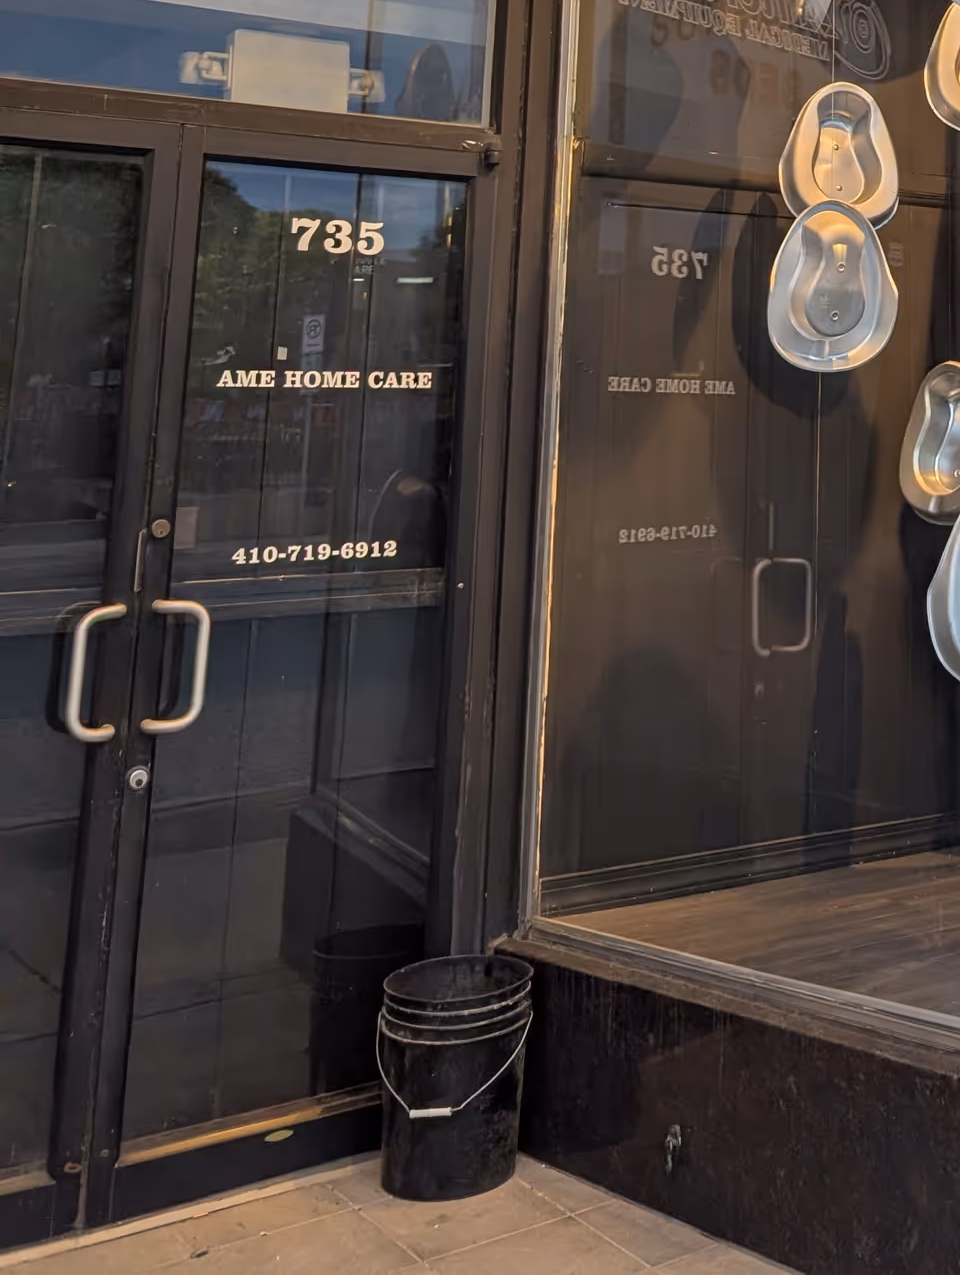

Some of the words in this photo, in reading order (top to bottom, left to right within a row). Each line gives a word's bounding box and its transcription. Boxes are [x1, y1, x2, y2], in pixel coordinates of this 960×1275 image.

[291, 218, 385, 255] 735
[216, 370, 275, 388] AME
[284, 370, 360, 389] HOME
[368, 371, 432, 389] CARE
[232, 541, 398, 565] 410-719-6912
